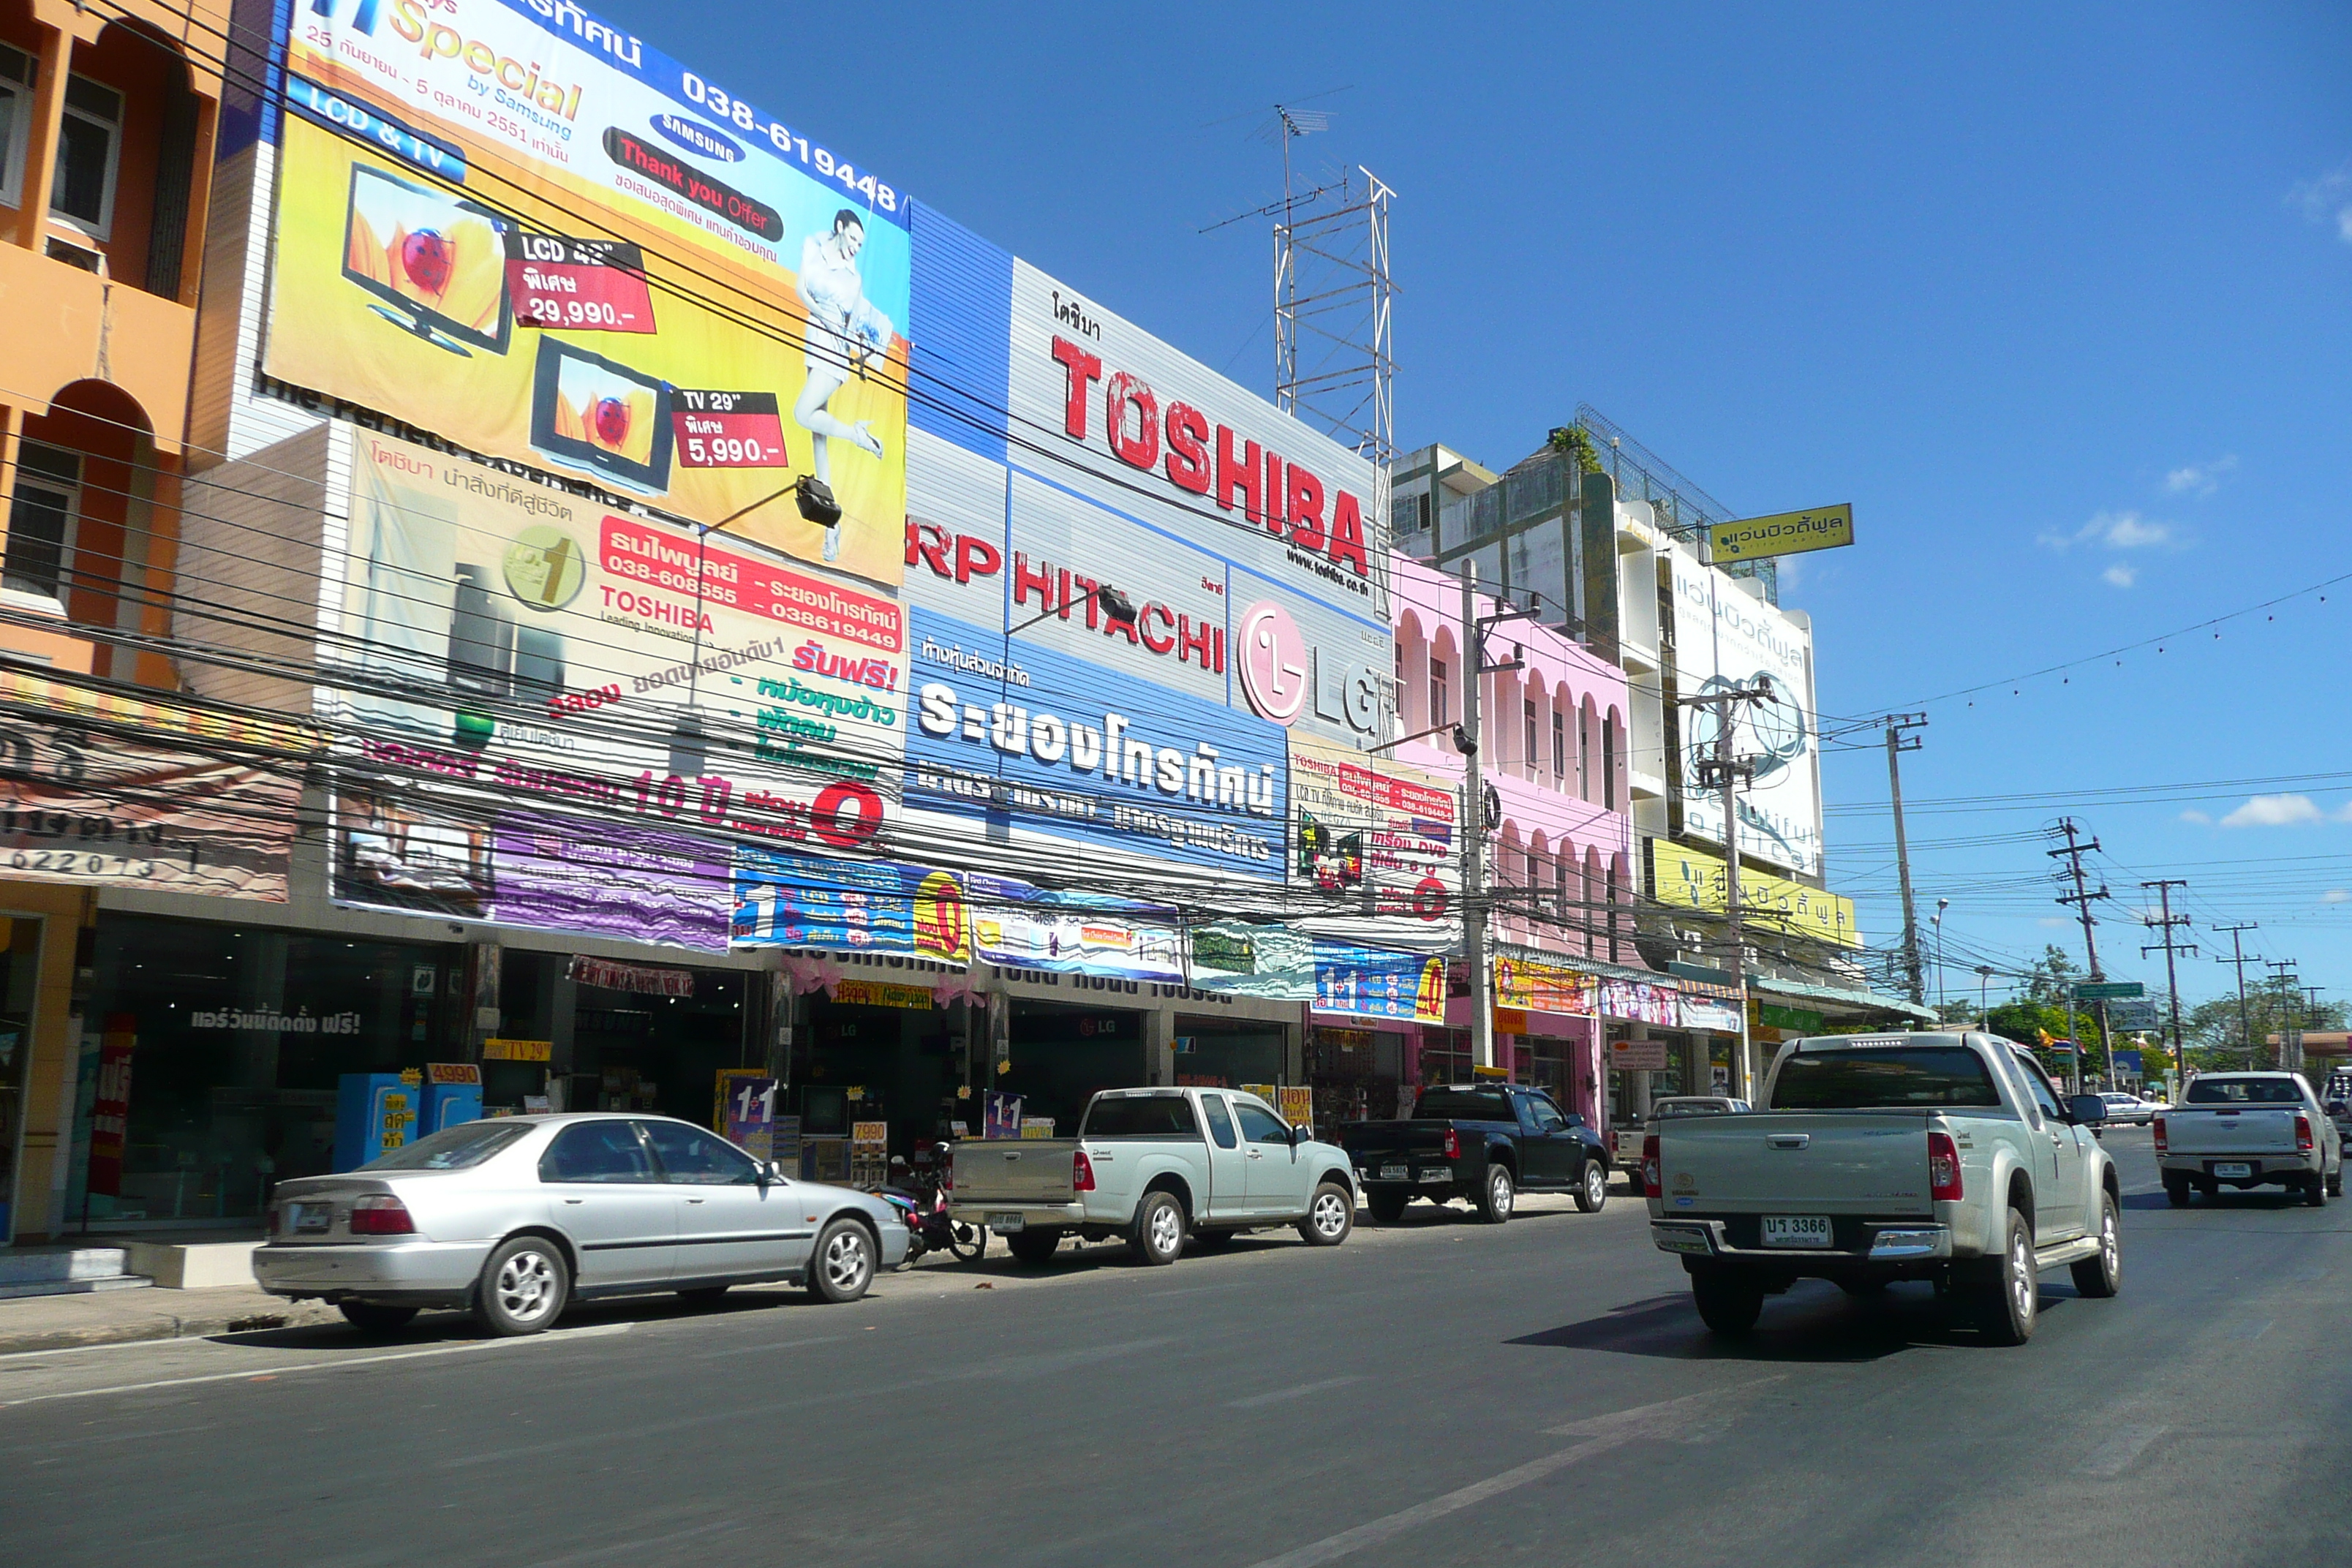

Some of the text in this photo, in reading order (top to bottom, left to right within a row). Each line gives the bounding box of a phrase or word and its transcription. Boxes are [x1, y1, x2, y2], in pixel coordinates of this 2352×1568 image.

[388, 0, 582, 122] Special
[306, 25, 332, 48] 25
[339, 39, 397, 79] กันยายน
[416, 79, 428, 94] 5
[434, 90, 481, 119] ตุลาคม
[487, 111, 527, 143] 2551
[532, 137, 568, 163] เท่านั้น
[467, 75, 571, 141] by Samsung
[309, 87, 446, 170] LCD & TV
[662, 113, 735, 163] SAMSUNG
[682, 72, 897, 212] 038-619448
[621, 137, 768, 230] Thank you Offer
[615, 173, 777, 263] ขอเสนอสุดพิเศษ แทนคำขอบคุณ
[522, 236, 565, 262] LCD
[523, 268, 576, 293] พิเศษ
[529, 298, 635, 326] 29,990.-
[1052, 290, 1101, 341] โตชิบา
[683, 392, 704, 410] TV
[685, 415, 723, 434] พิเศษ
[689, 438, 780, 467] 5,990.-
[1052, 333, 1369, 578] TOSHIBA
[371, 440, 573, 522] โตชิบา นำสิ่งที่ดีสู่ชีวิต
[1730, 516, 1842, 543] แว่นบิวตี้ฟูล
[608, 555, 736, 603] 038-608555
[772, 602, 897, 649] 038619449
[611, 531, 738, 584] ธนไพบูลย์
[770, 580, 897, 630] ระยองโทรทัศน์
[600, 585, 715, 635] TOSHIBA
[600, 611, 641, 632] Leading
[792, 639, 900, 696] รับฟรี!
[1314, 645, 1378, 735] LG
[757, 676, 897, 726] หม้อหุงข้าว
[919, 683, 1275, 816] ระยองโทรทัศน์
[1294, 753, 1339, 777] TOSHIBA
[322, 1010, 361, 1035] ฟรี!
[1098, 1019, 1115, 1033] LG
[1793, 1219, 1827, 1233] 3366
